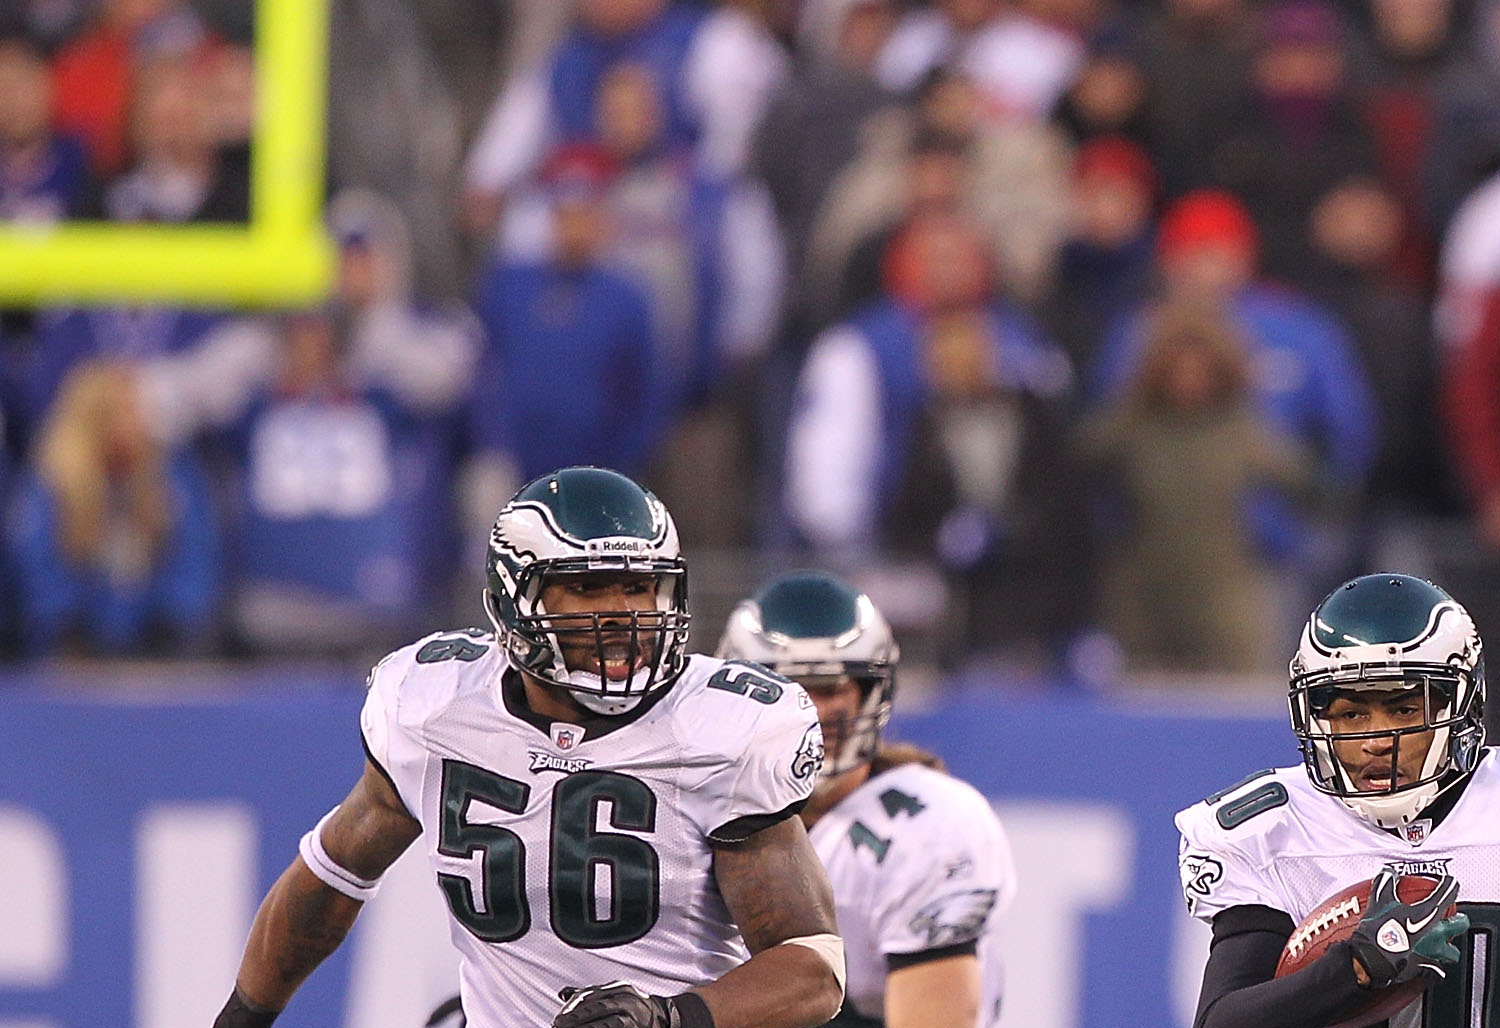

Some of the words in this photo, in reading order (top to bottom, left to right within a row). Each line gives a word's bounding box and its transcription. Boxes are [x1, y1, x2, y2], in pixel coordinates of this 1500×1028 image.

[603, 541, 639, 551] Riddell
[707, 659, 792, 705] 5
[530, 751, 590, 773] EAGLES
[848, 787, 926, 864] 14
[437, 758, 661, 950] 56
[1388, 859, 1451, 877] EAGLES
